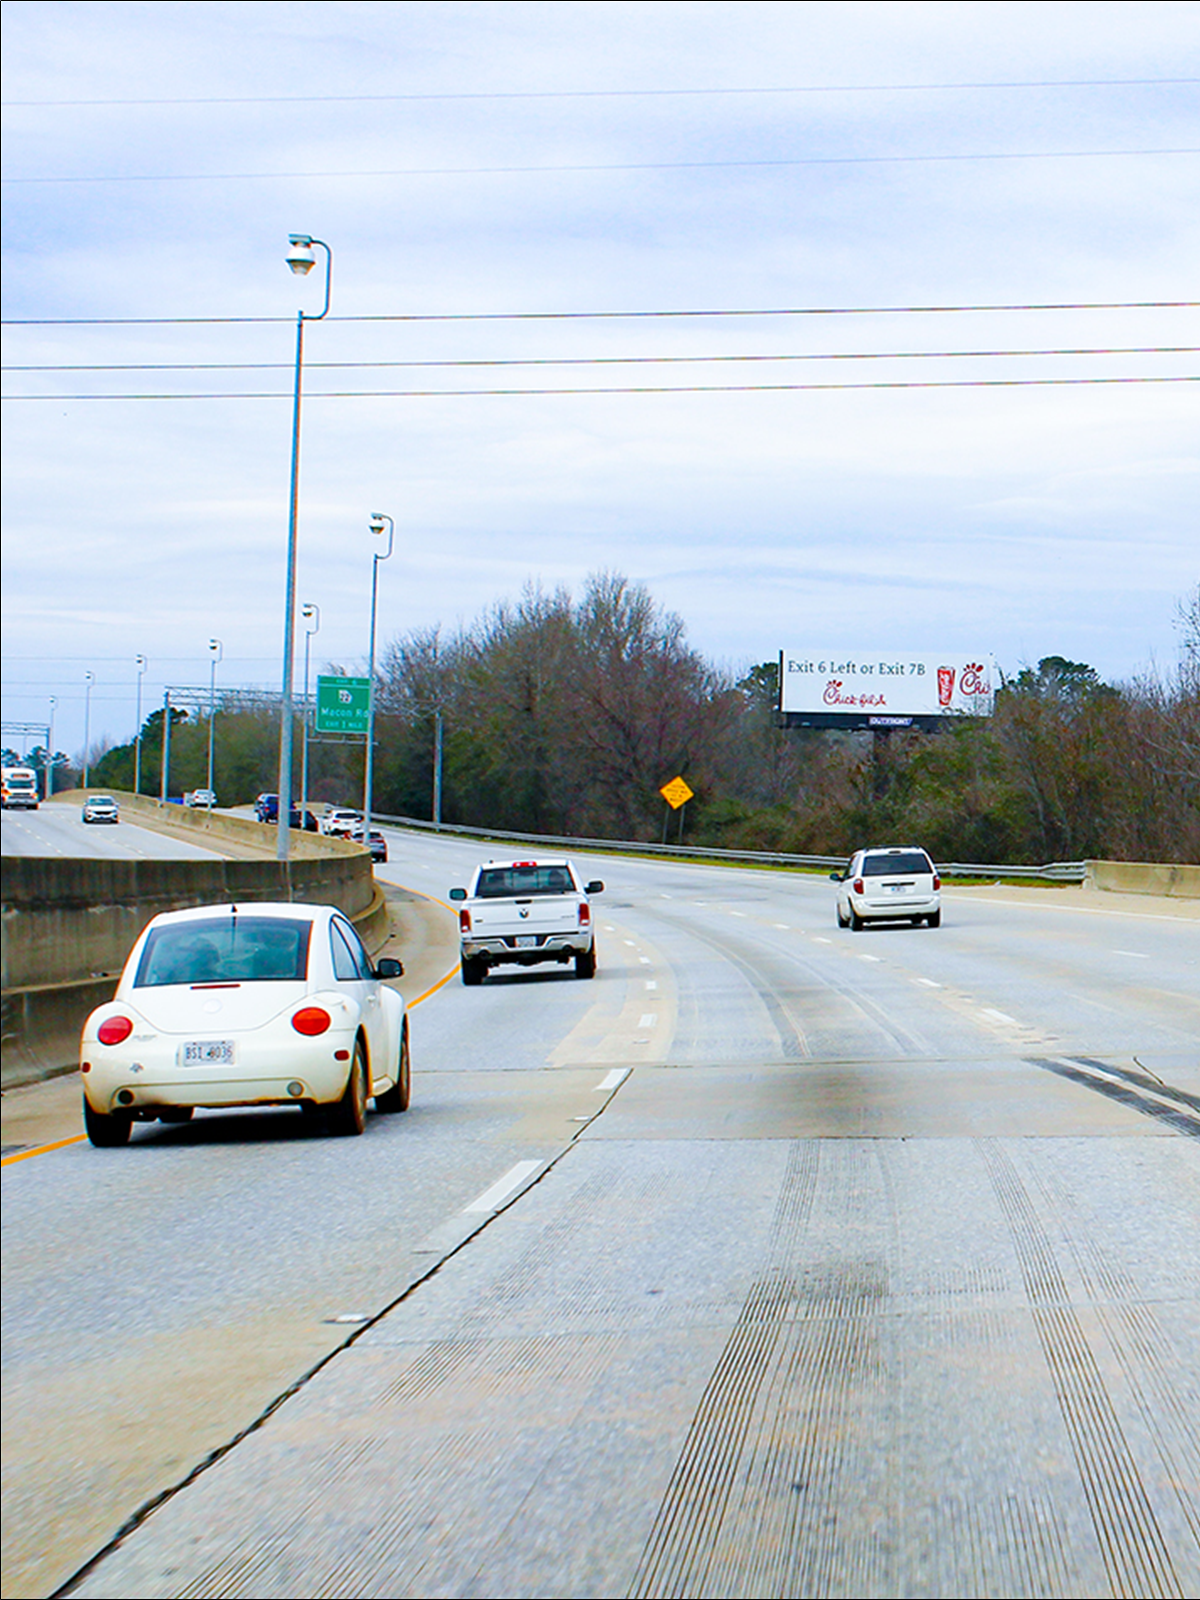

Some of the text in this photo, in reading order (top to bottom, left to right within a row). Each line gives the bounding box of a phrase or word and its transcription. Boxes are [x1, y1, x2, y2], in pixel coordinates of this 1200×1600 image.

[788, 660, 926, 676] Exit 6 Left or Exit 7B
[321, 707, 353, 718] Macon
